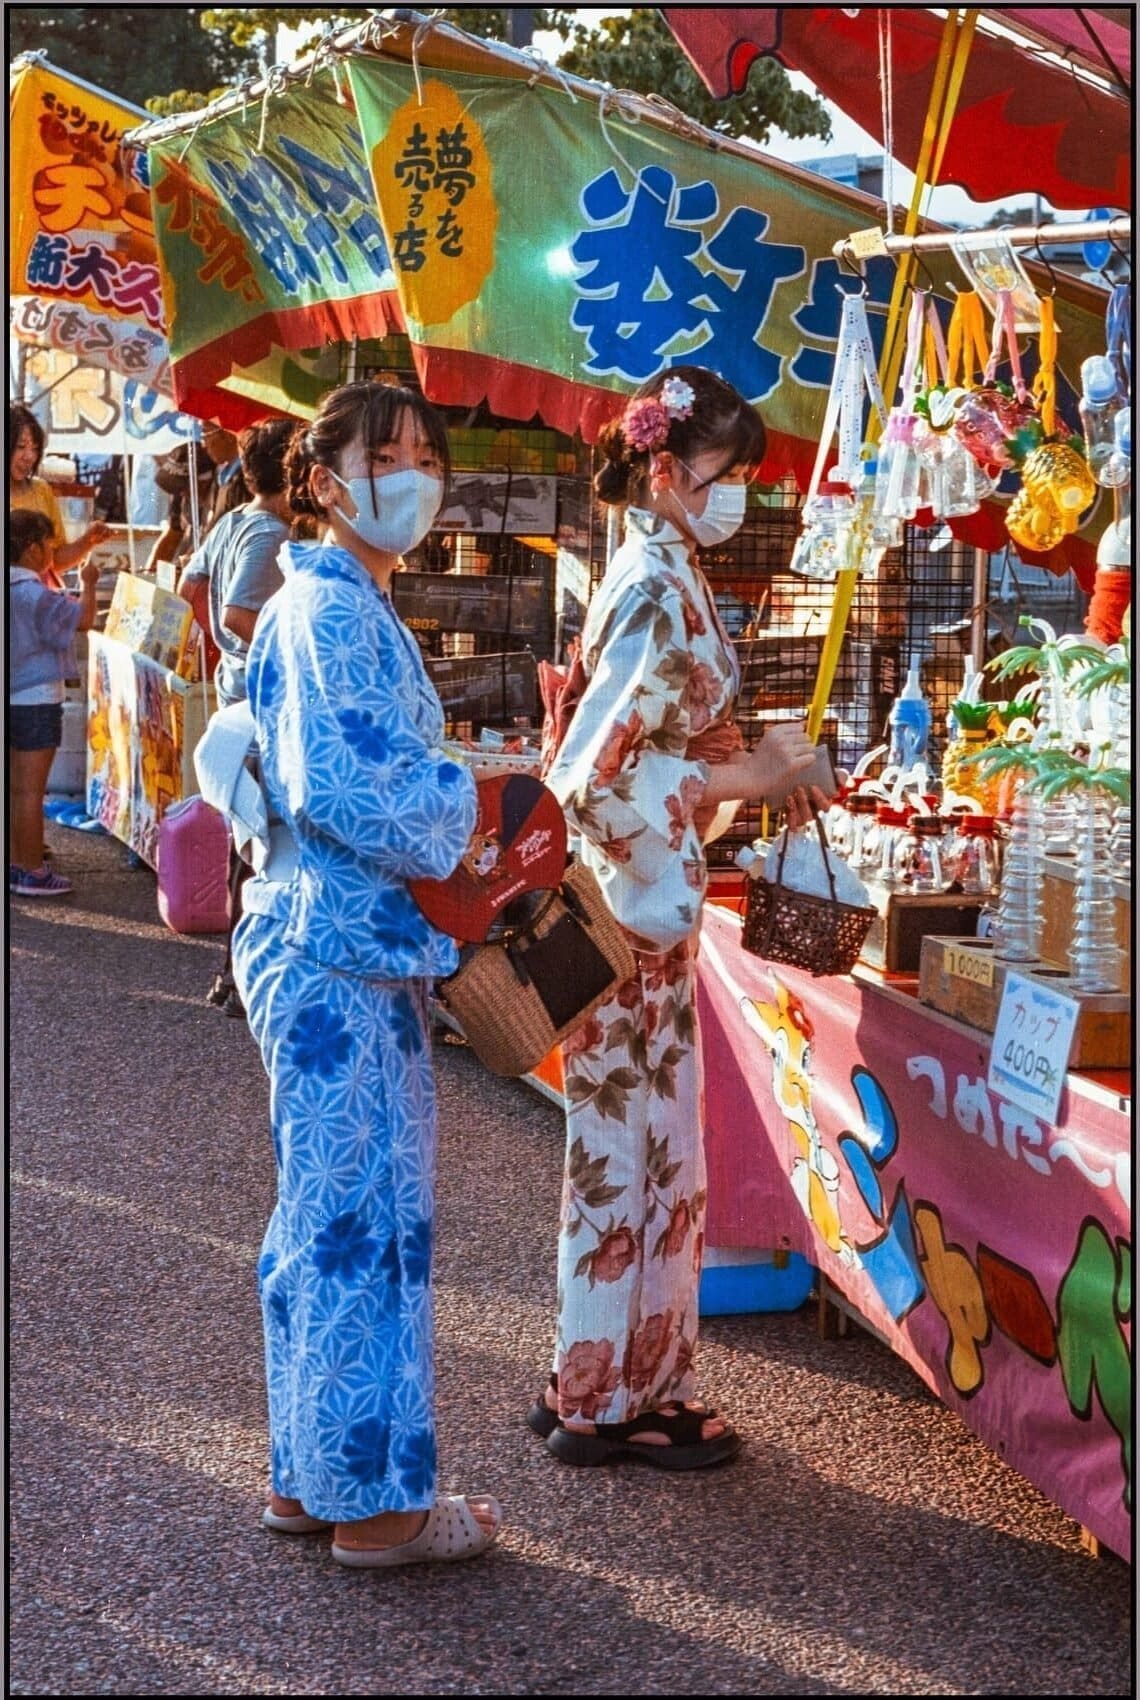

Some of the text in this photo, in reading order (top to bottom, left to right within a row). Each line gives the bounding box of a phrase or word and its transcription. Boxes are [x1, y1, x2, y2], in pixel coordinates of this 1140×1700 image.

[41, 92, 126, 143] モッツァレ
[393, 122, 435, 272] 売る店
[434, 122, 476, 257] 夢を
[949, 953, 990, 981] 1000円
[1011, 1001, 1062, 1042] カップ
[1003, 1039, 1051, 1087] 400円
